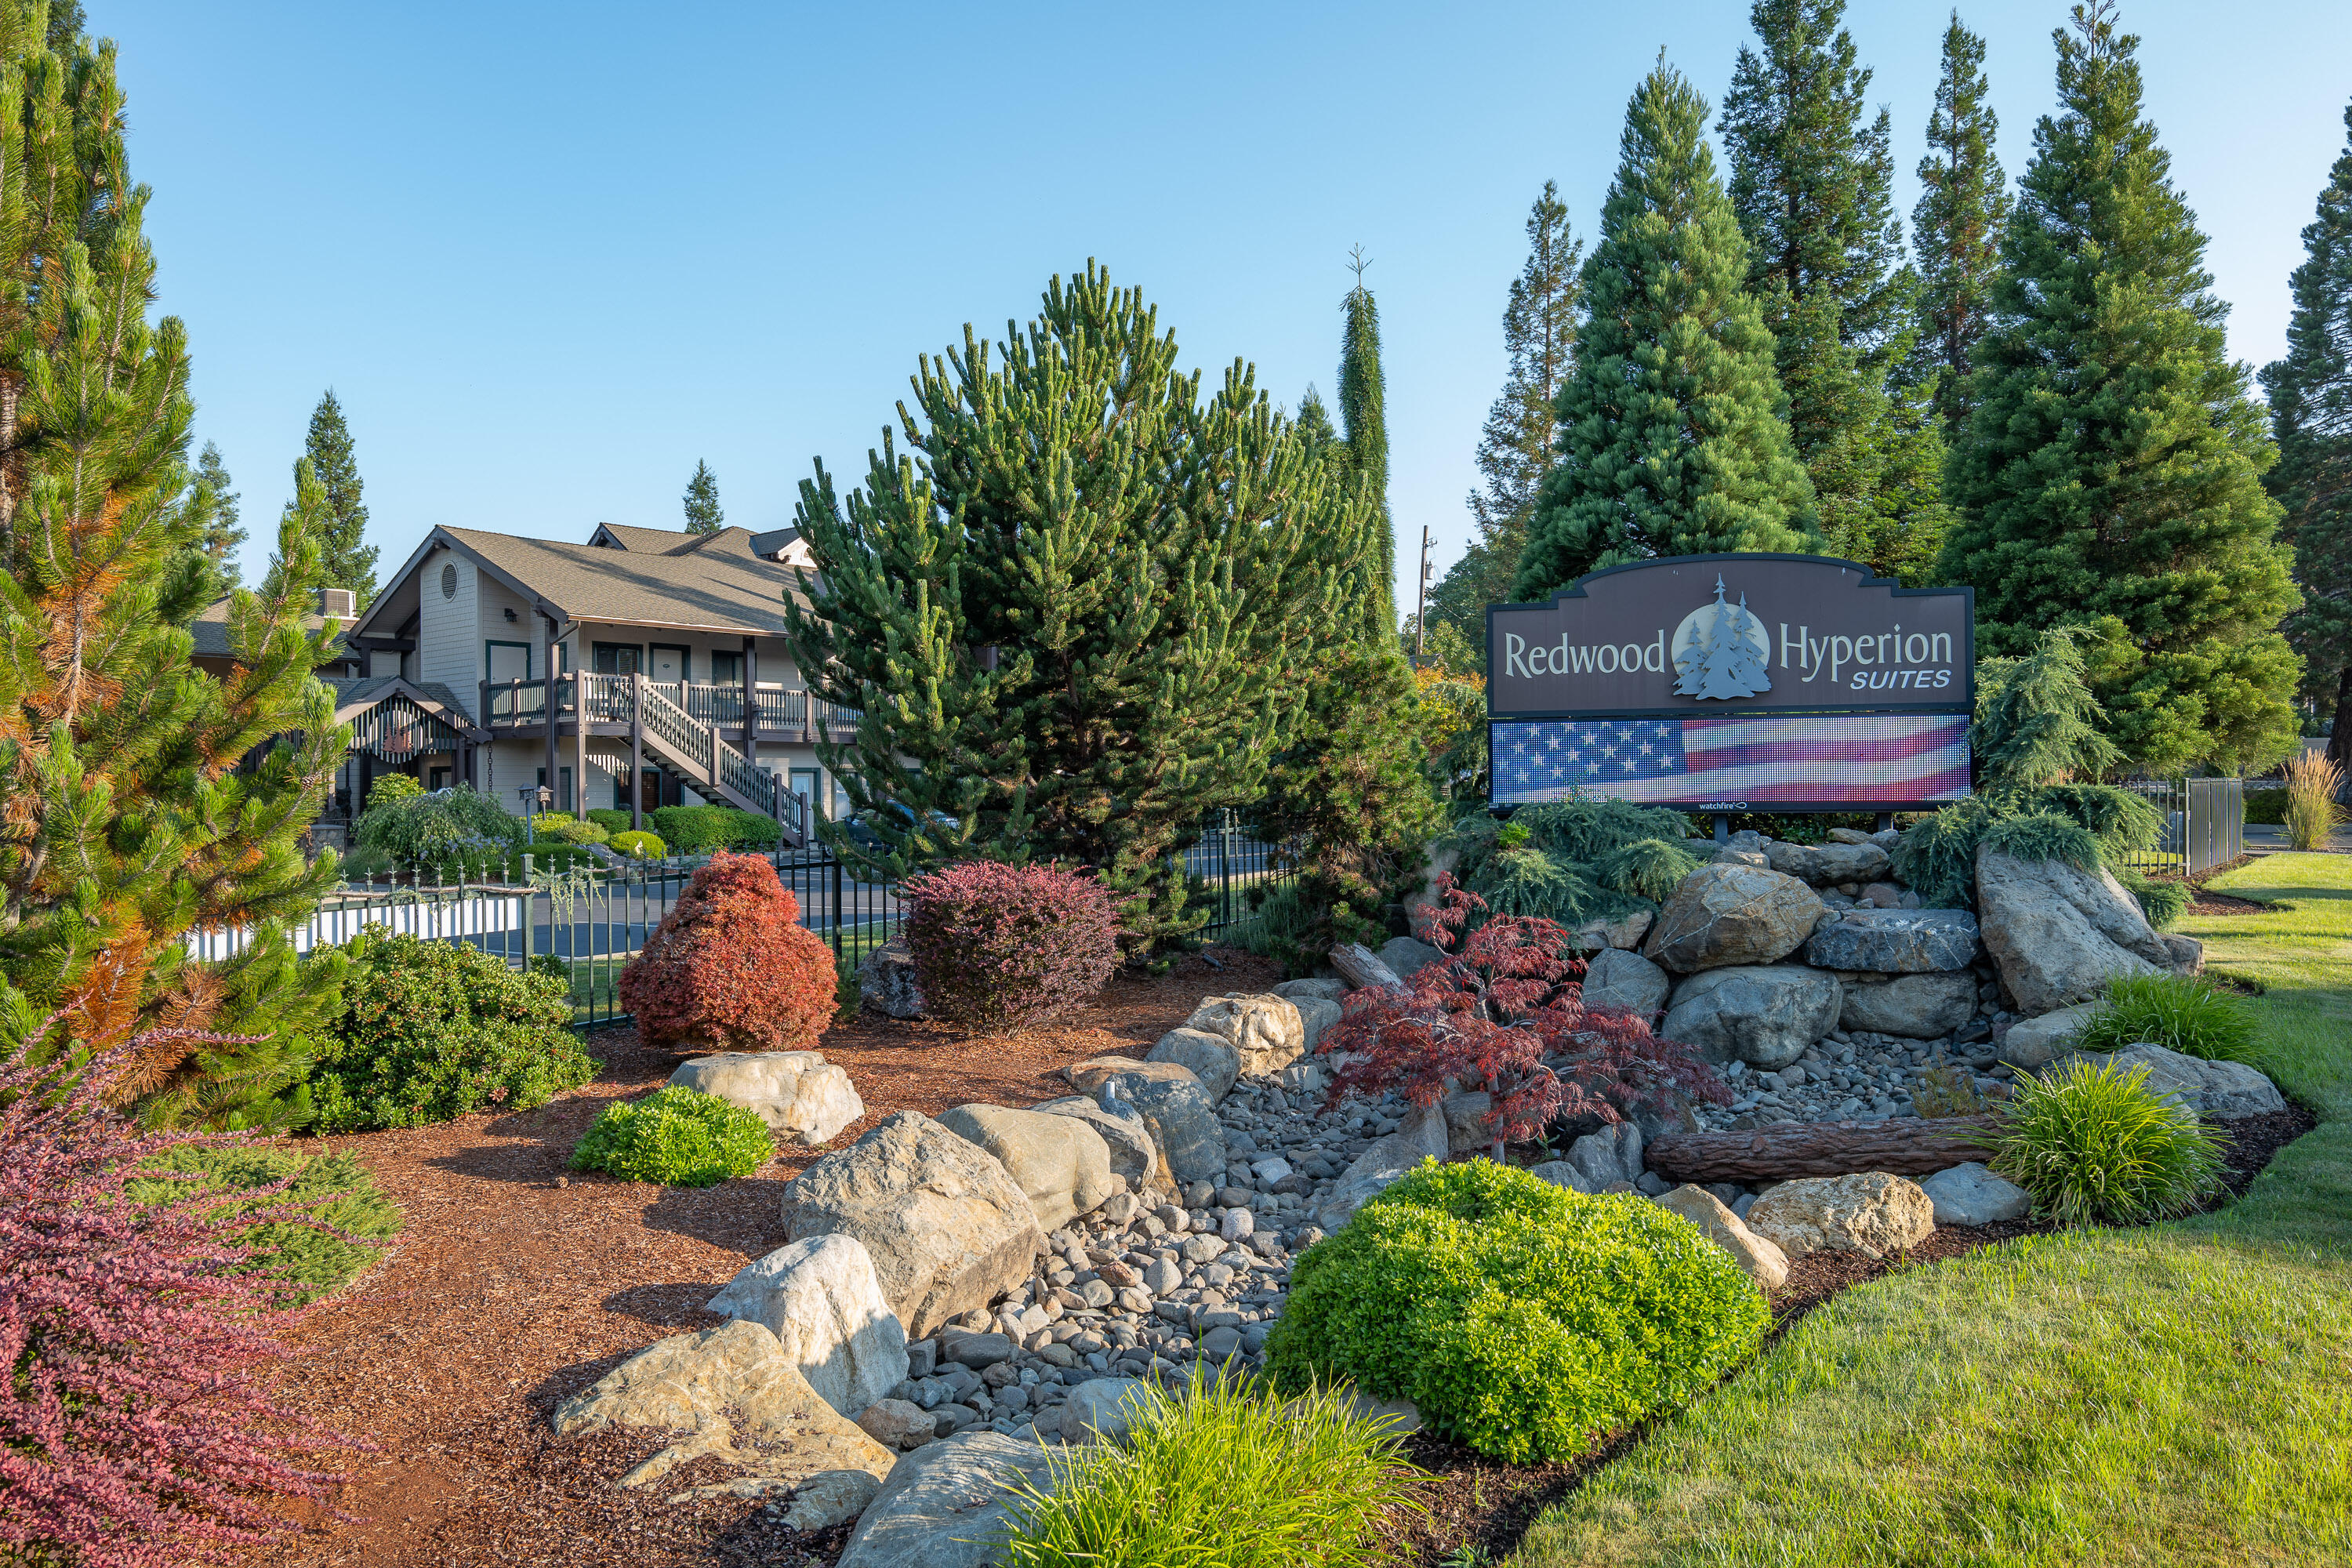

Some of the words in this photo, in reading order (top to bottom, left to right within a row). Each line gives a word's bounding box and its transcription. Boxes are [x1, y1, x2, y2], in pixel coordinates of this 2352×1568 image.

[1504, 628, 1665, 679] Redwood
[1780, 622, 1952, 683] Hyperion
[1849, 669, 1952, 690] SUITES
